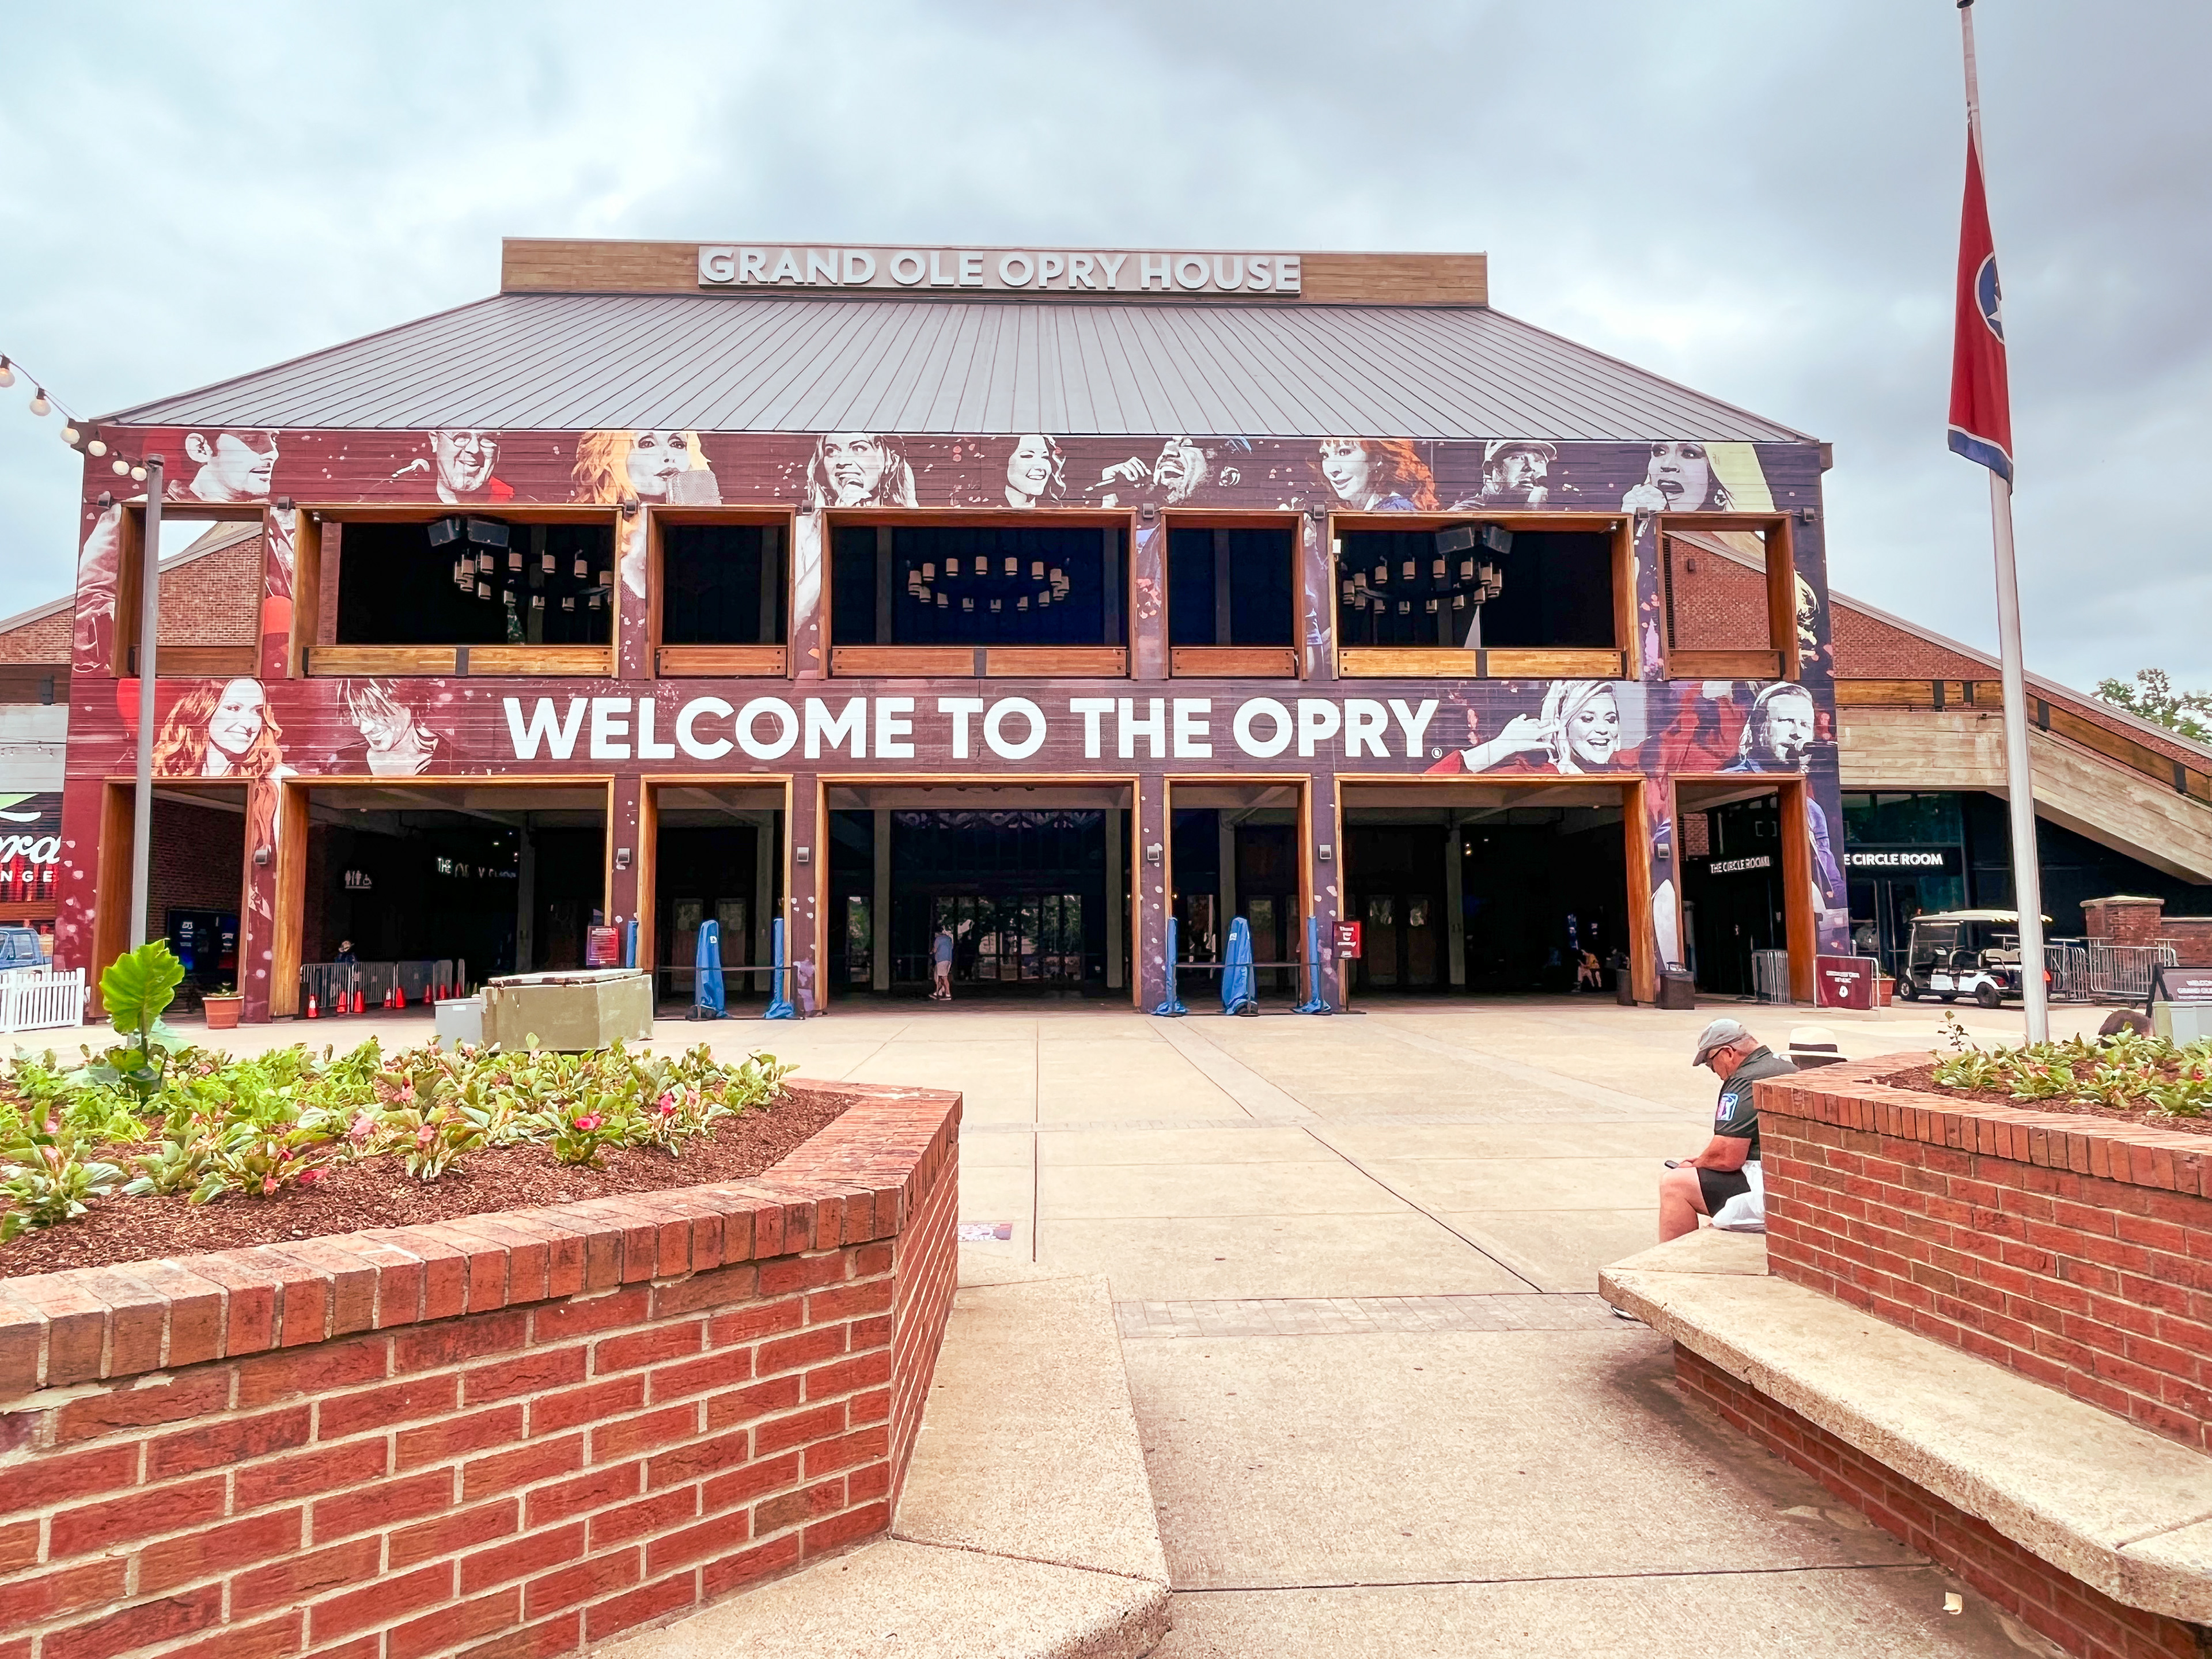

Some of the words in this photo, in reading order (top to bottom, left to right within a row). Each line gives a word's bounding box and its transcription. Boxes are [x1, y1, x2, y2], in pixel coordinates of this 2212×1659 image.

[700, 247, 876, 285] GRAND
[889, 250, 984, 287] OLE
[999, 252, 1127, 289] OPRY
[1141, 254, 1301, 291] HOUSE
[503, 697, 915, 760] WELCOME
[938, 697, 1047, 760] TO
[1070, 698, 1213, 759] THE
[1233, 697, 1440, 758] OPRY
[1852, 853, 1900, 865] CIRCLE
[1900, 853, 1944, 865] ROOM
